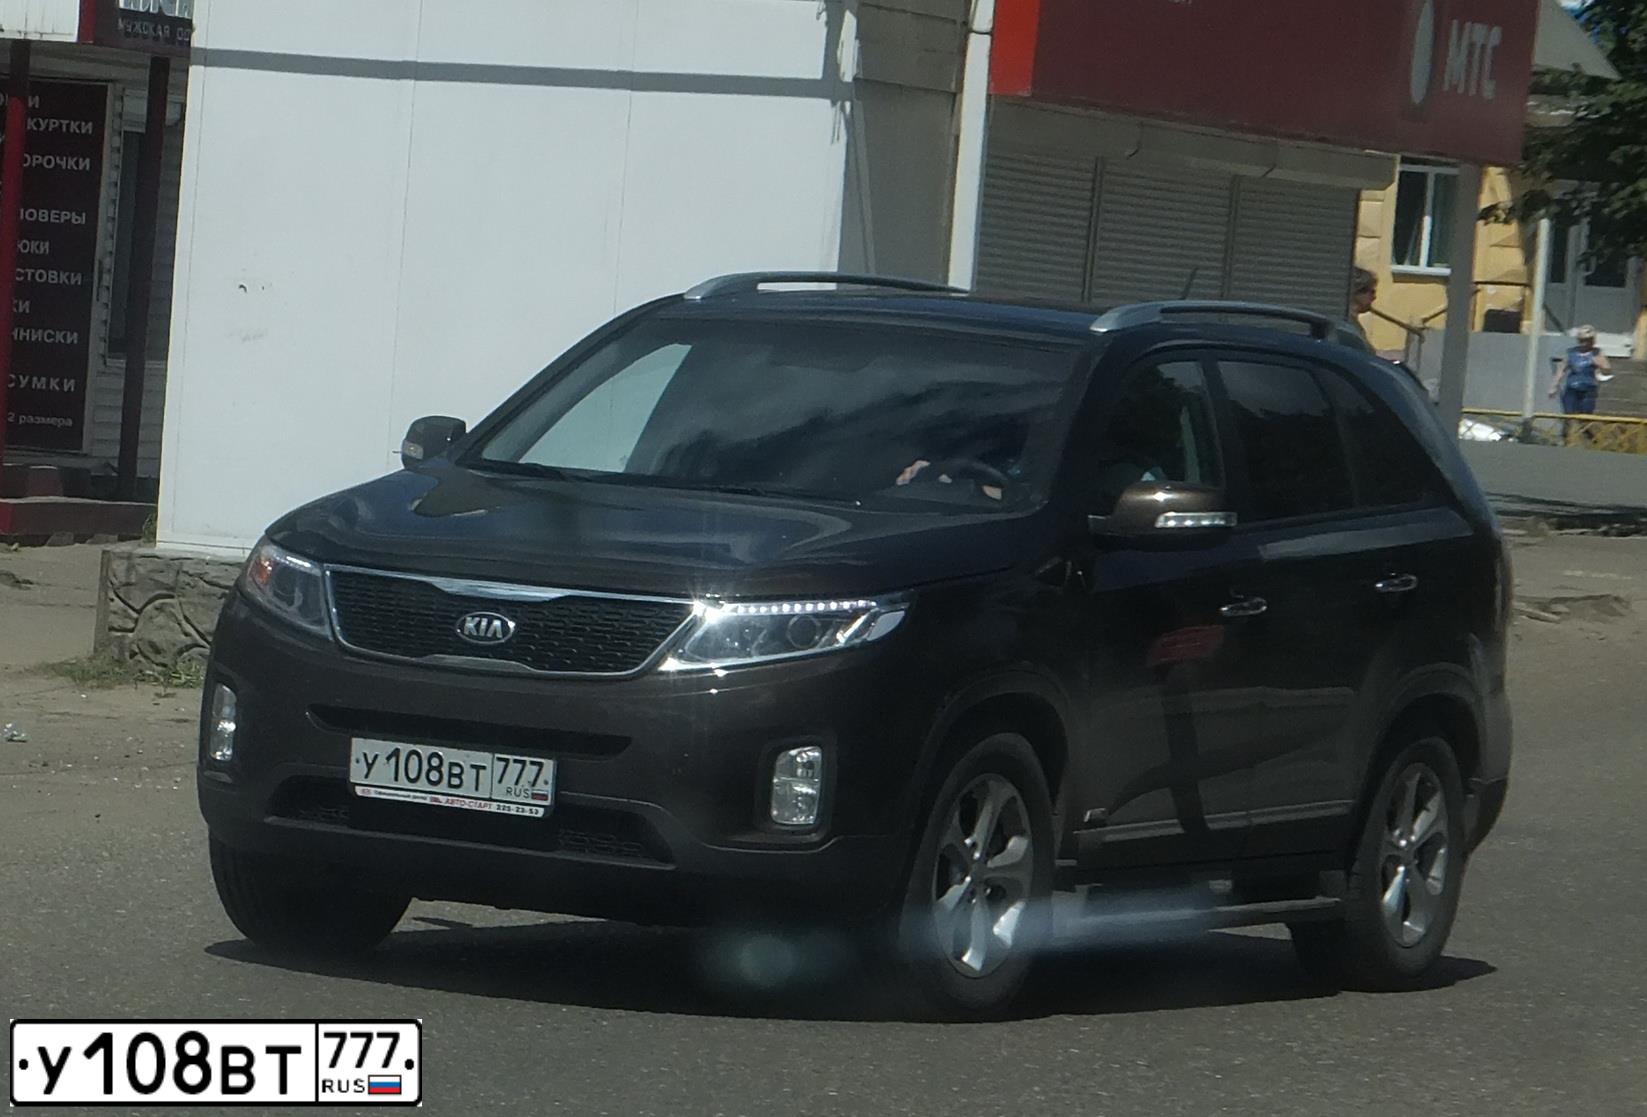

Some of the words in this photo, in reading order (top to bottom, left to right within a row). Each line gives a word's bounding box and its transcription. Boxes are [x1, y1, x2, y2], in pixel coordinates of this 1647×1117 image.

[1442, 19, 1503, 100] МТС
[27, 117, 93, 134] КУРТКИ
[19, 413, 73, 428] размера
[463, 616, 503, 638] KIA
[496, 756, 545, 788] 777
[505, 786, 530, 800] RUS
